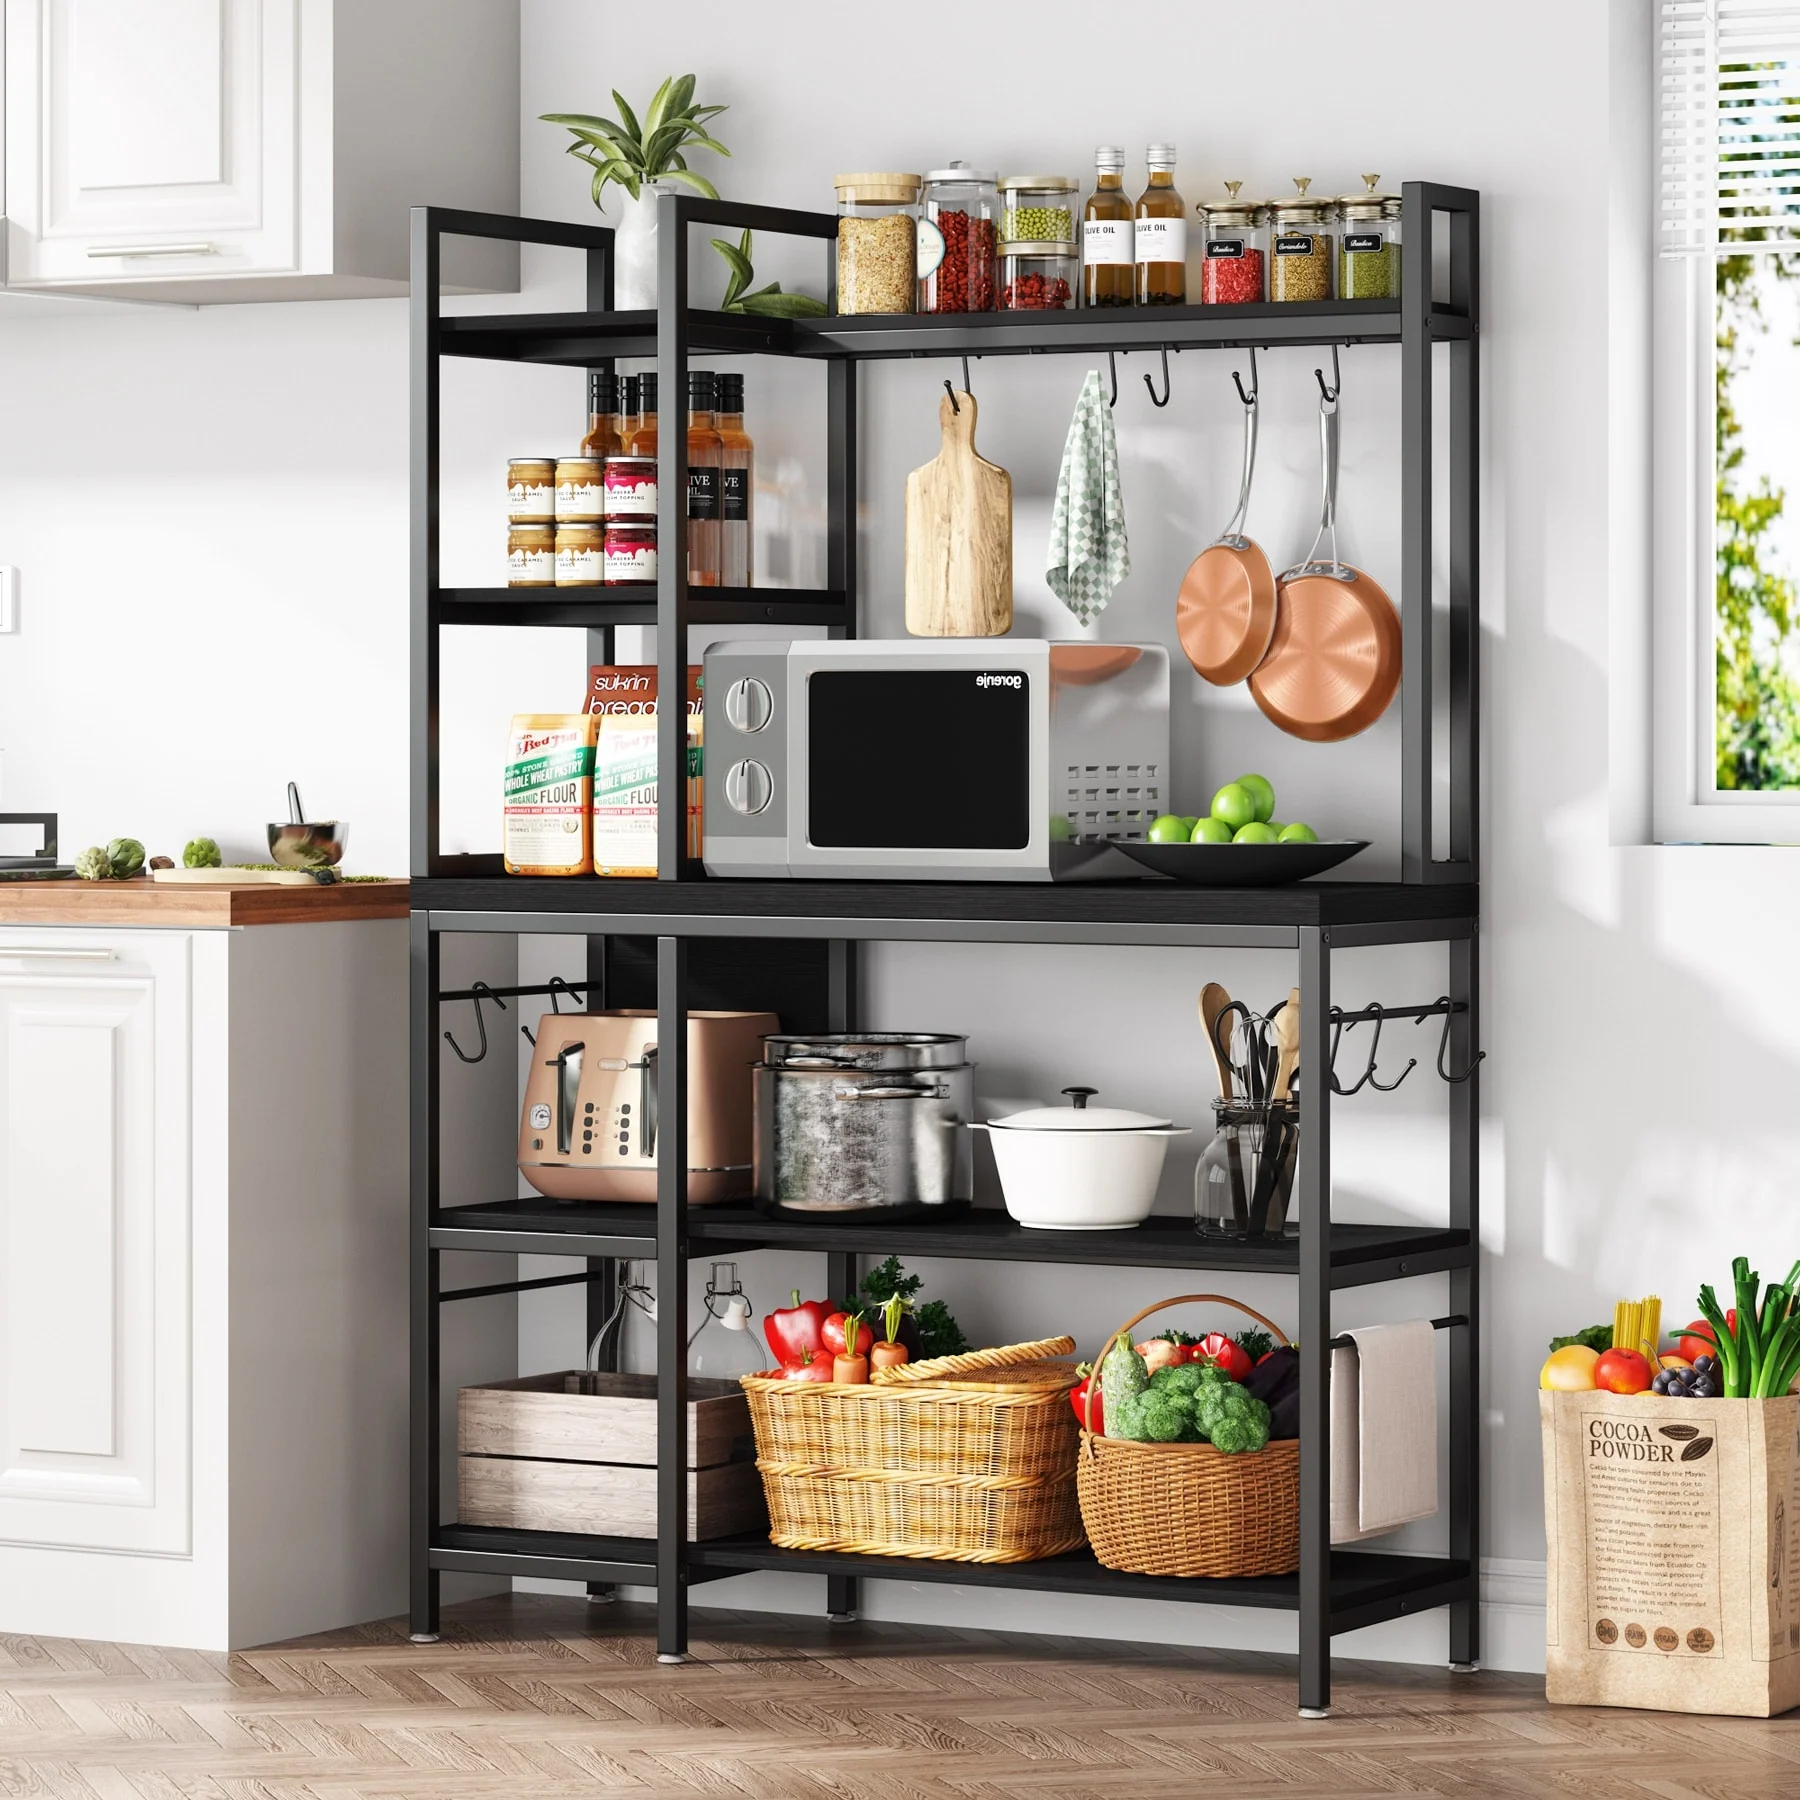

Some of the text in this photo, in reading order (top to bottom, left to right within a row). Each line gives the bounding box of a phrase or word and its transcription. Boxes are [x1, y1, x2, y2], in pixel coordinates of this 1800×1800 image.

[1102, 226, 1116, 234] OIL
[690, 475, 710, 486] IVE
[522, 736, 550, 755] Red
[504, 773, 529, 792] WHOLE
[530, 766, 554, 785] WHEAT
[554, 759, 583, 778] PASTRY
[508, 782, 577, 805] ORGANIC FLOUR
[630, 786, 658, 804] FLOU
[1589, 1420, 1653, 1442] COCOA
[1589, 1440, 1674, 1462] POWDER
